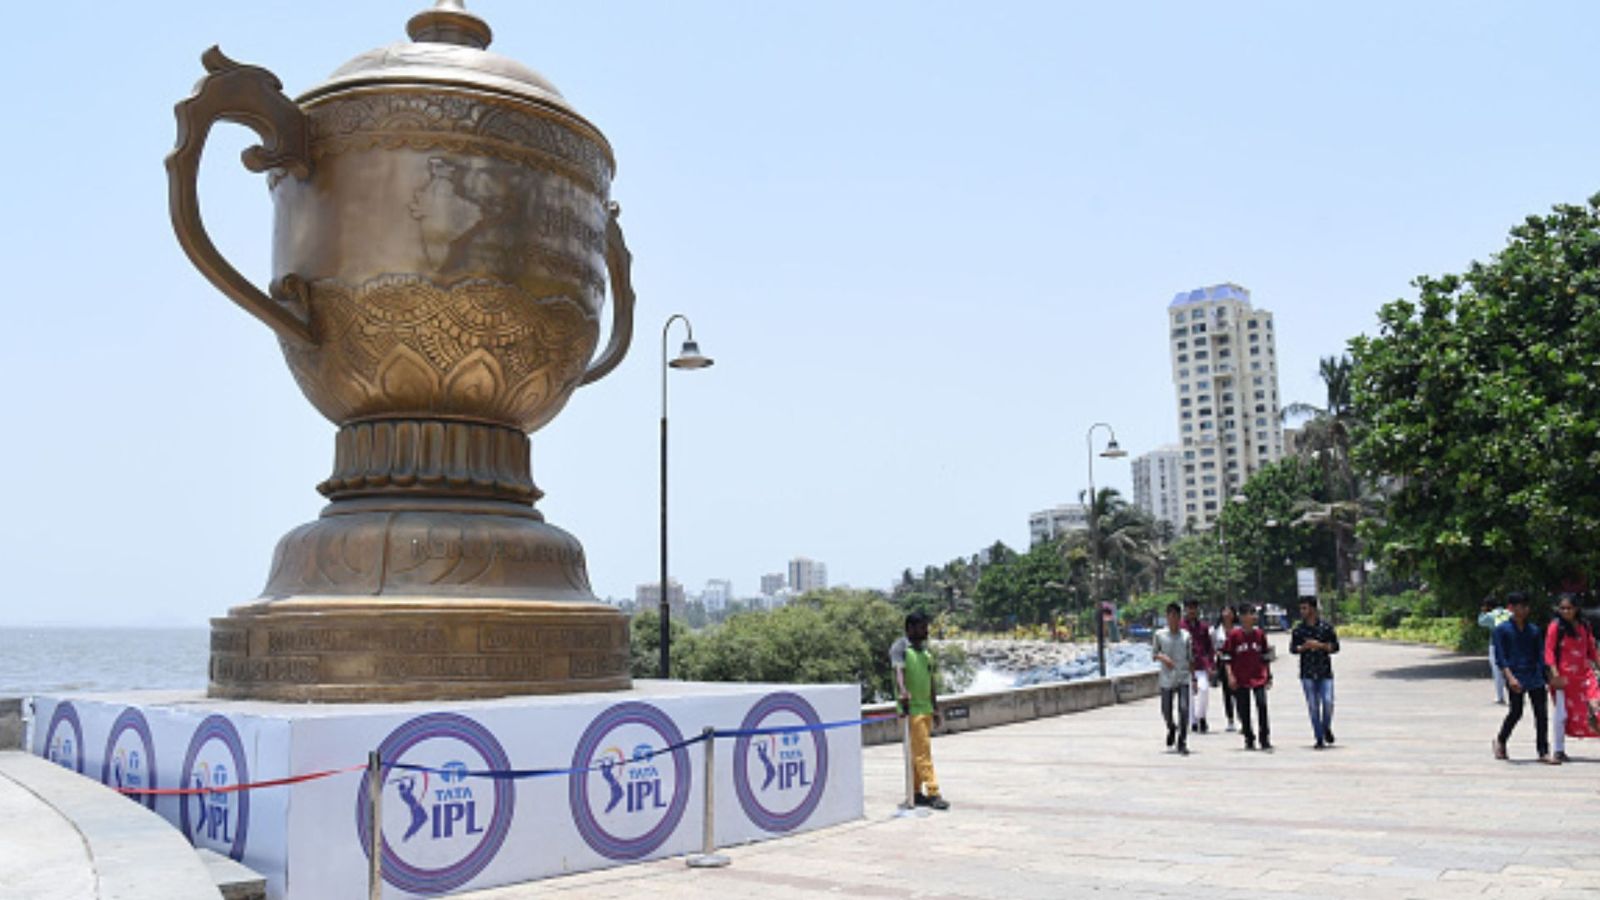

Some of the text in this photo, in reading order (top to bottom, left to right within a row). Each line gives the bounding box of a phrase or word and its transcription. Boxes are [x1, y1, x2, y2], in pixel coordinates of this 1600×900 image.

[629, 767, 658, 779] TATA
[778, 760, 811, 790] IPL
[435, 787, 472, 801] TATA
[627, 779, 667, 812] IPL
[208, 805, 232, 844] IPL
[432, 801, 483, 838] IPL
